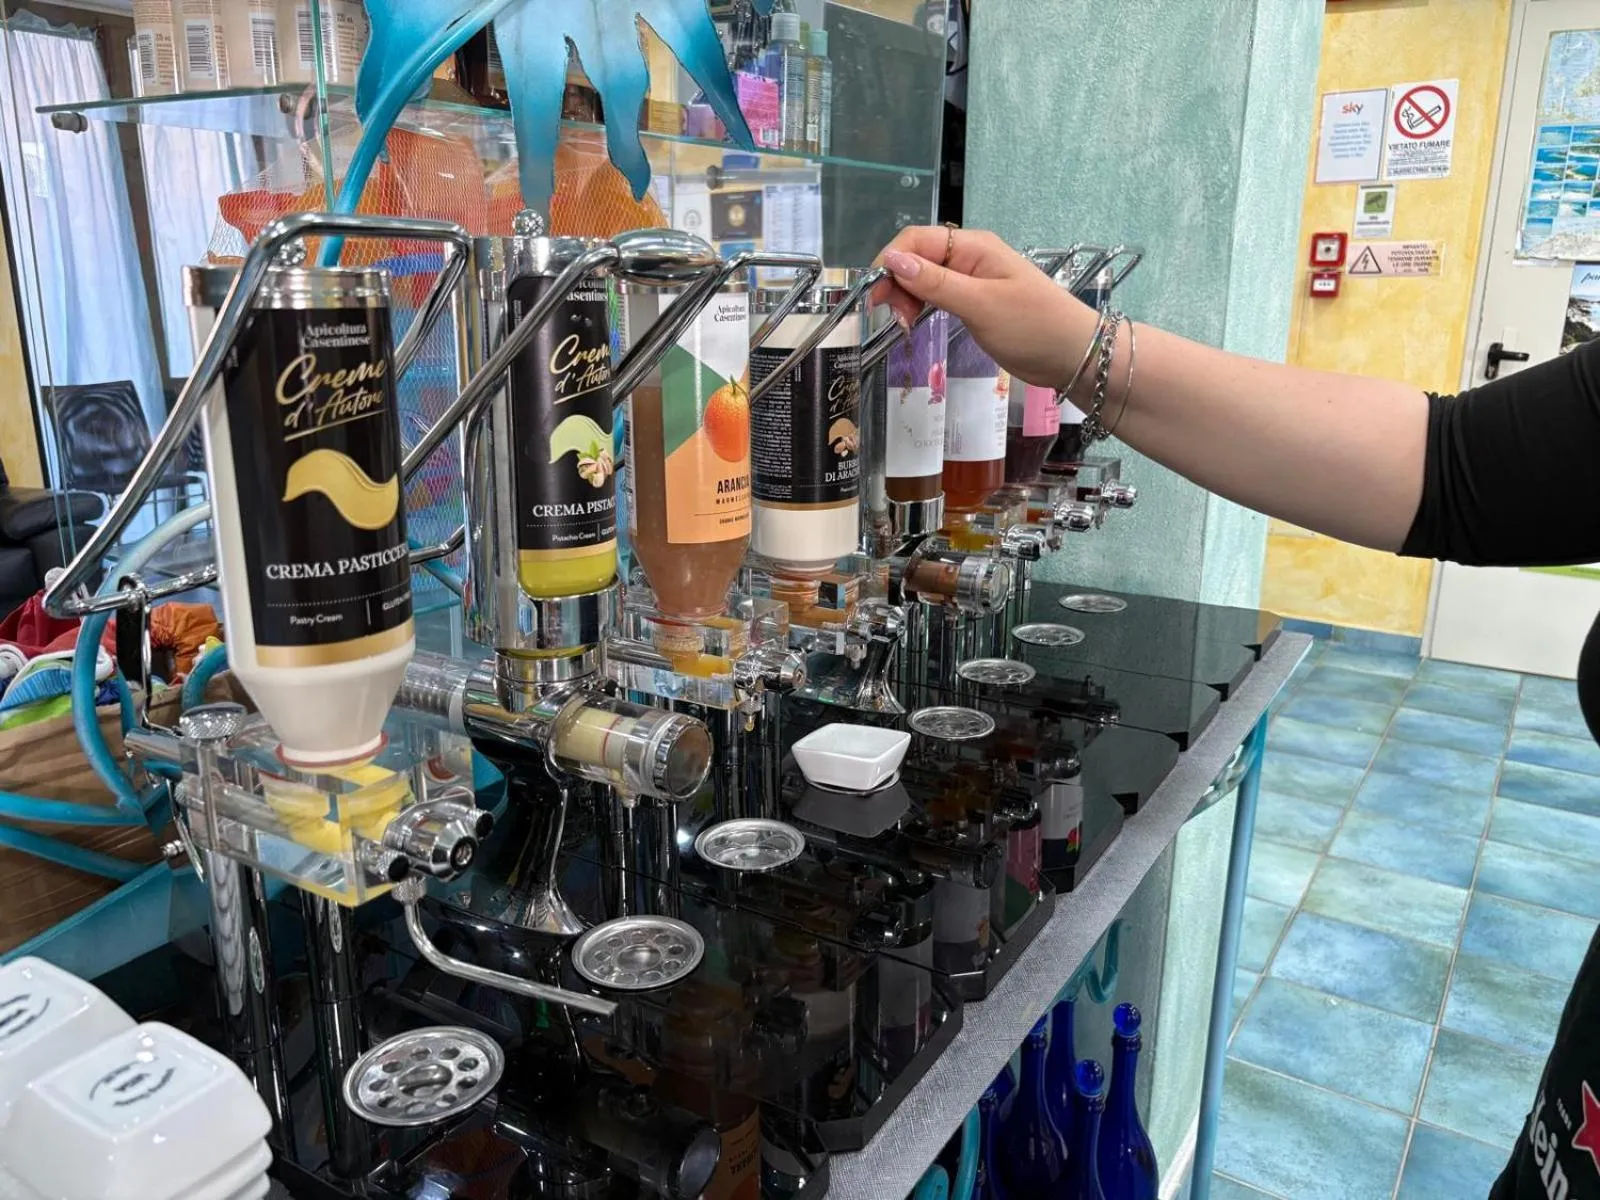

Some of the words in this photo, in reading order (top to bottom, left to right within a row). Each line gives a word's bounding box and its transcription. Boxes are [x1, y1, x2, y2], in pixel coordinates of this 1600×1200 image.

[1341, 102, 1364, 115] sky
[1388, 142, 1418, 151] VIETATO
[1420, 140, 1450, 149] FUMARE
[305, 324, 367, 337] Apicoltura
[302, 336, 373, 348] Casentinese
[275, 353, 386, 405] Creme
[532, 503, 585, 518] CREMA
[265, 561, 336, 580] CREMA
[338, 543, 409, 576] PASTICCE
[289, 615, 315, 627] Pastry
[316, 613, 344, 624] Cream
